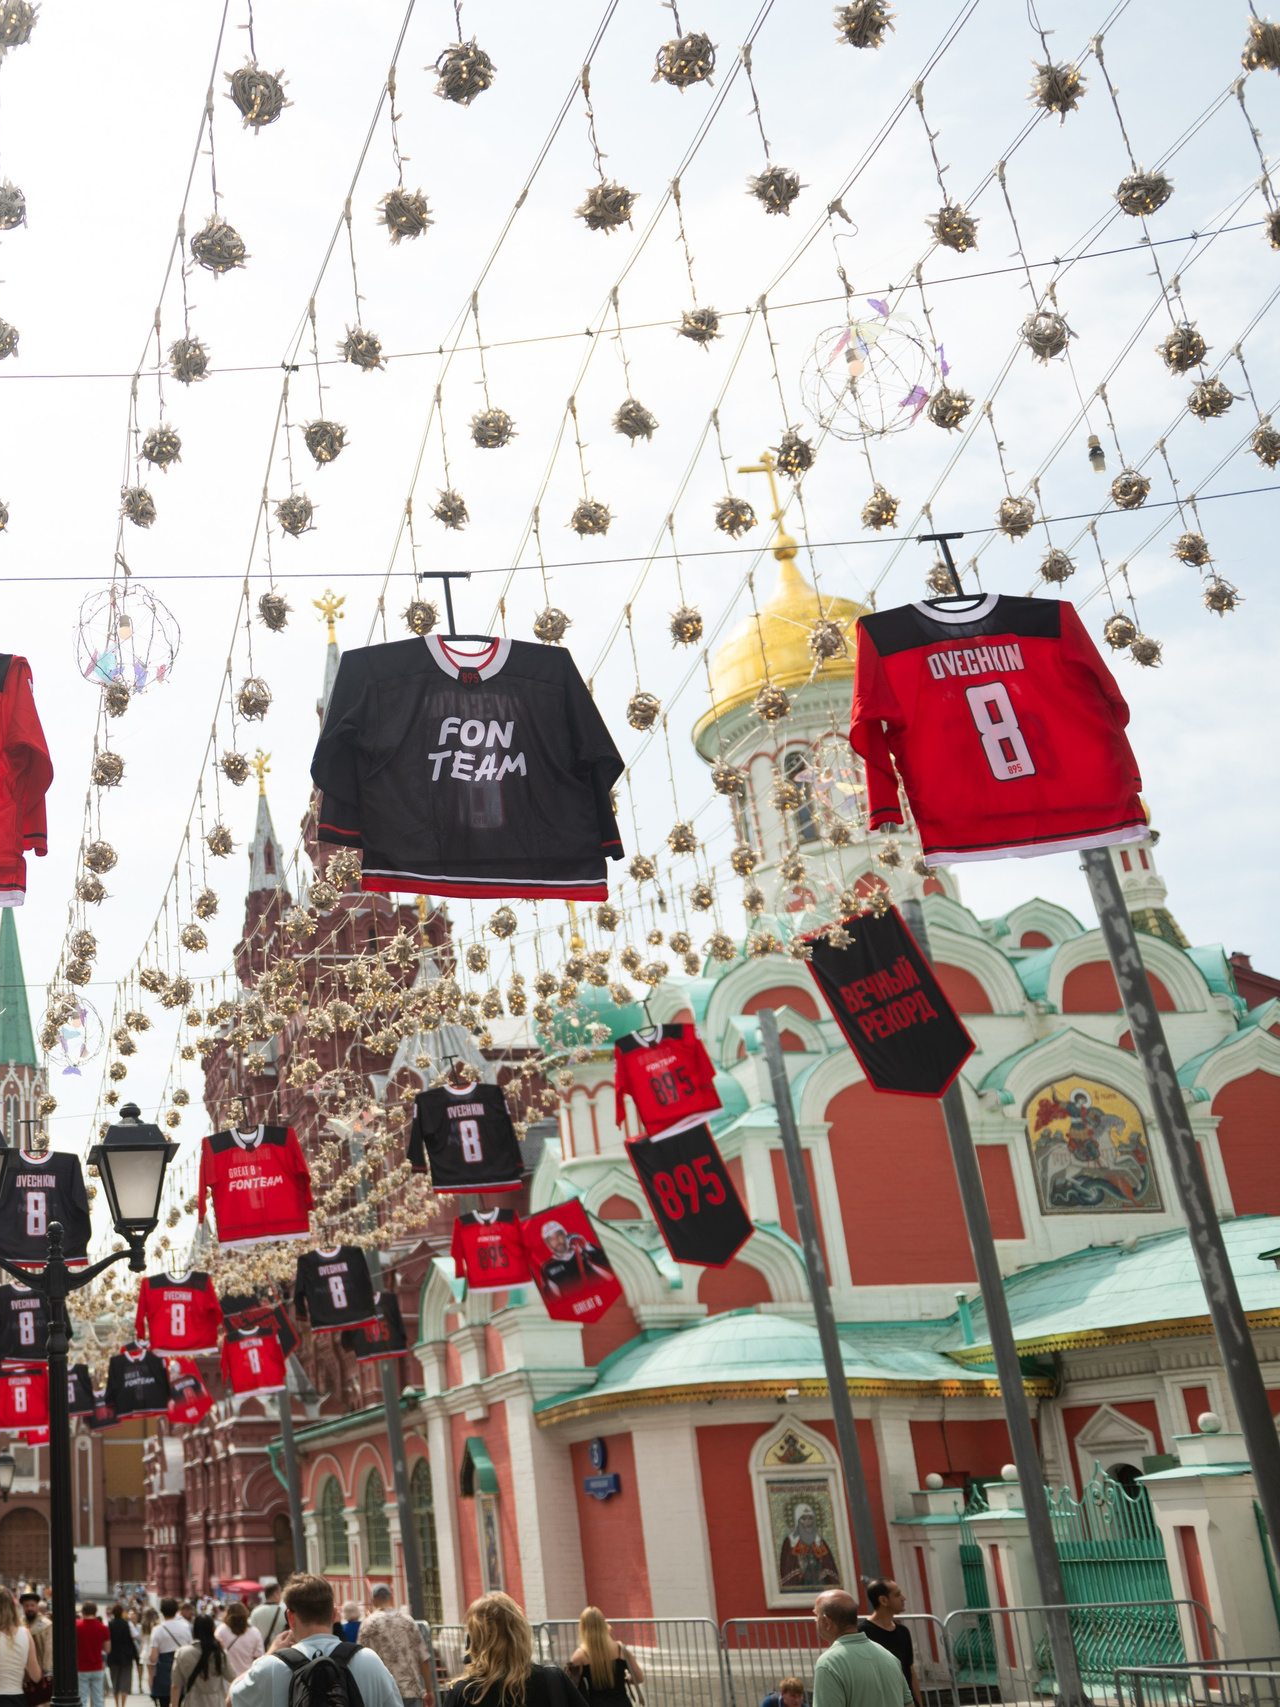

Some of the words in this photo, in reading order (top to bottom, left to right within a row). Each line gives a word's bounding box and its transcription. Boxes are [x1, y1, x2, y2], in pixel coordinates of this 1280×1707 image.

[461, 672, 480, 684] 895
[926, 643, 1025, 680] OVECHKIN
[437, 716, 515, 749] FON
[964, 680, 1037, 782] 8
[427, 750, 527, 782] TEAM
[1007, 763, 1023, 775] 895
[839, 955, 921, 1015] ВЕЧНЫЙ
[857, 989, 939, 1043] РЕКОРД
[650, 1065, 696, 1107] 895
[447, 1103, 485, 1119] OVECHKIN
[459, 1119, 483, 1163] 8
[15, 1174, 56, 1188] OVECHKIN
[228, 1165, 249, 1179] GREAT
[250, 1164, 256, 1176] 8
[228, 1174, 284, 1192] FONTEAM
[651, 1154, 727, 1221] 895
[26, 1191, 47, 1237] 8
[477, 1245, 510, 1270] 895
[327, 1275, 348, 1309] 8
[18, 1311, 35, 1346] 8
[171, 1303, 186, 1337] 8
[247, 1347, 261, 1375] 8
[14, 1386, 27, 1413] 8
